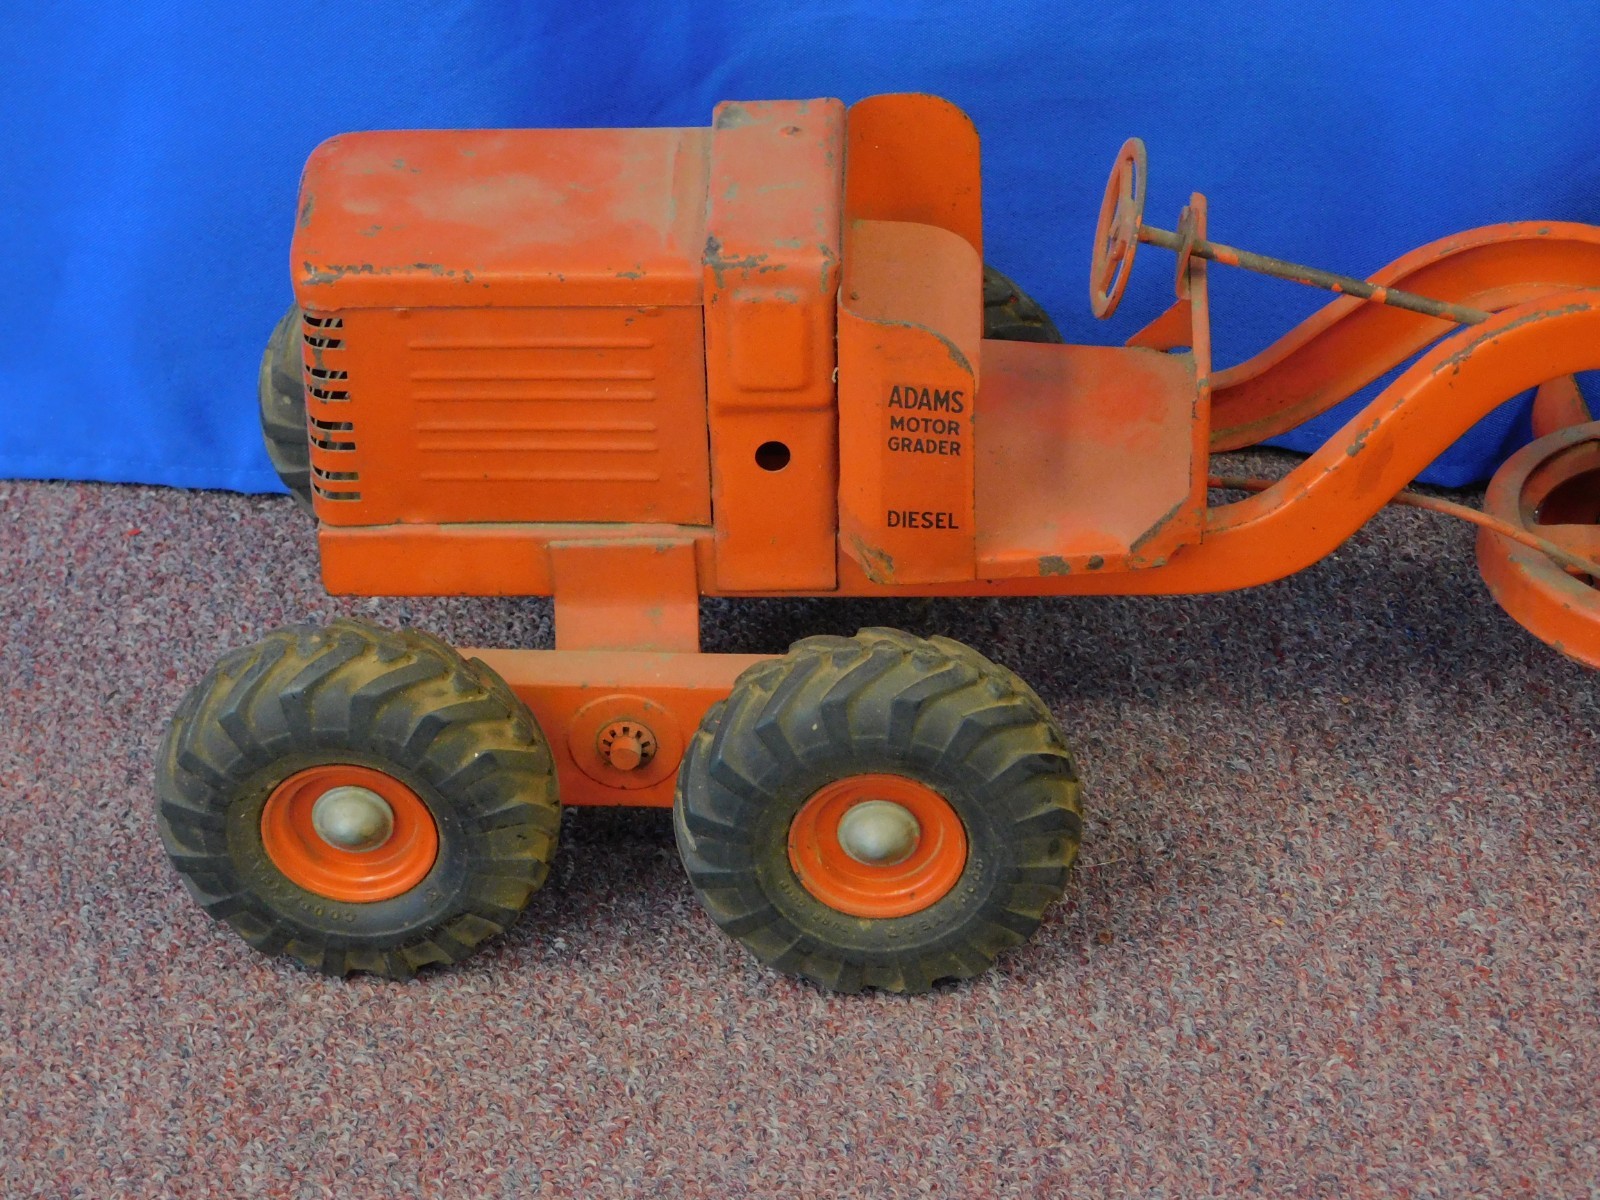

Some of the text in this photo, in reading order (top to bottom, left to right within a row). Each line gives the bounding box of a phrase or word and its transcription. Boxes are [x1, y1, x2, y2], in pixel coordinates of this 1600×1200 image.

[888, 385, 964, 414] ADAMS
[890, 415, 960, 436] MOTOR
[888, 436, 961, 456] GRADER
[887, 510, 959, 529] DIESEL
